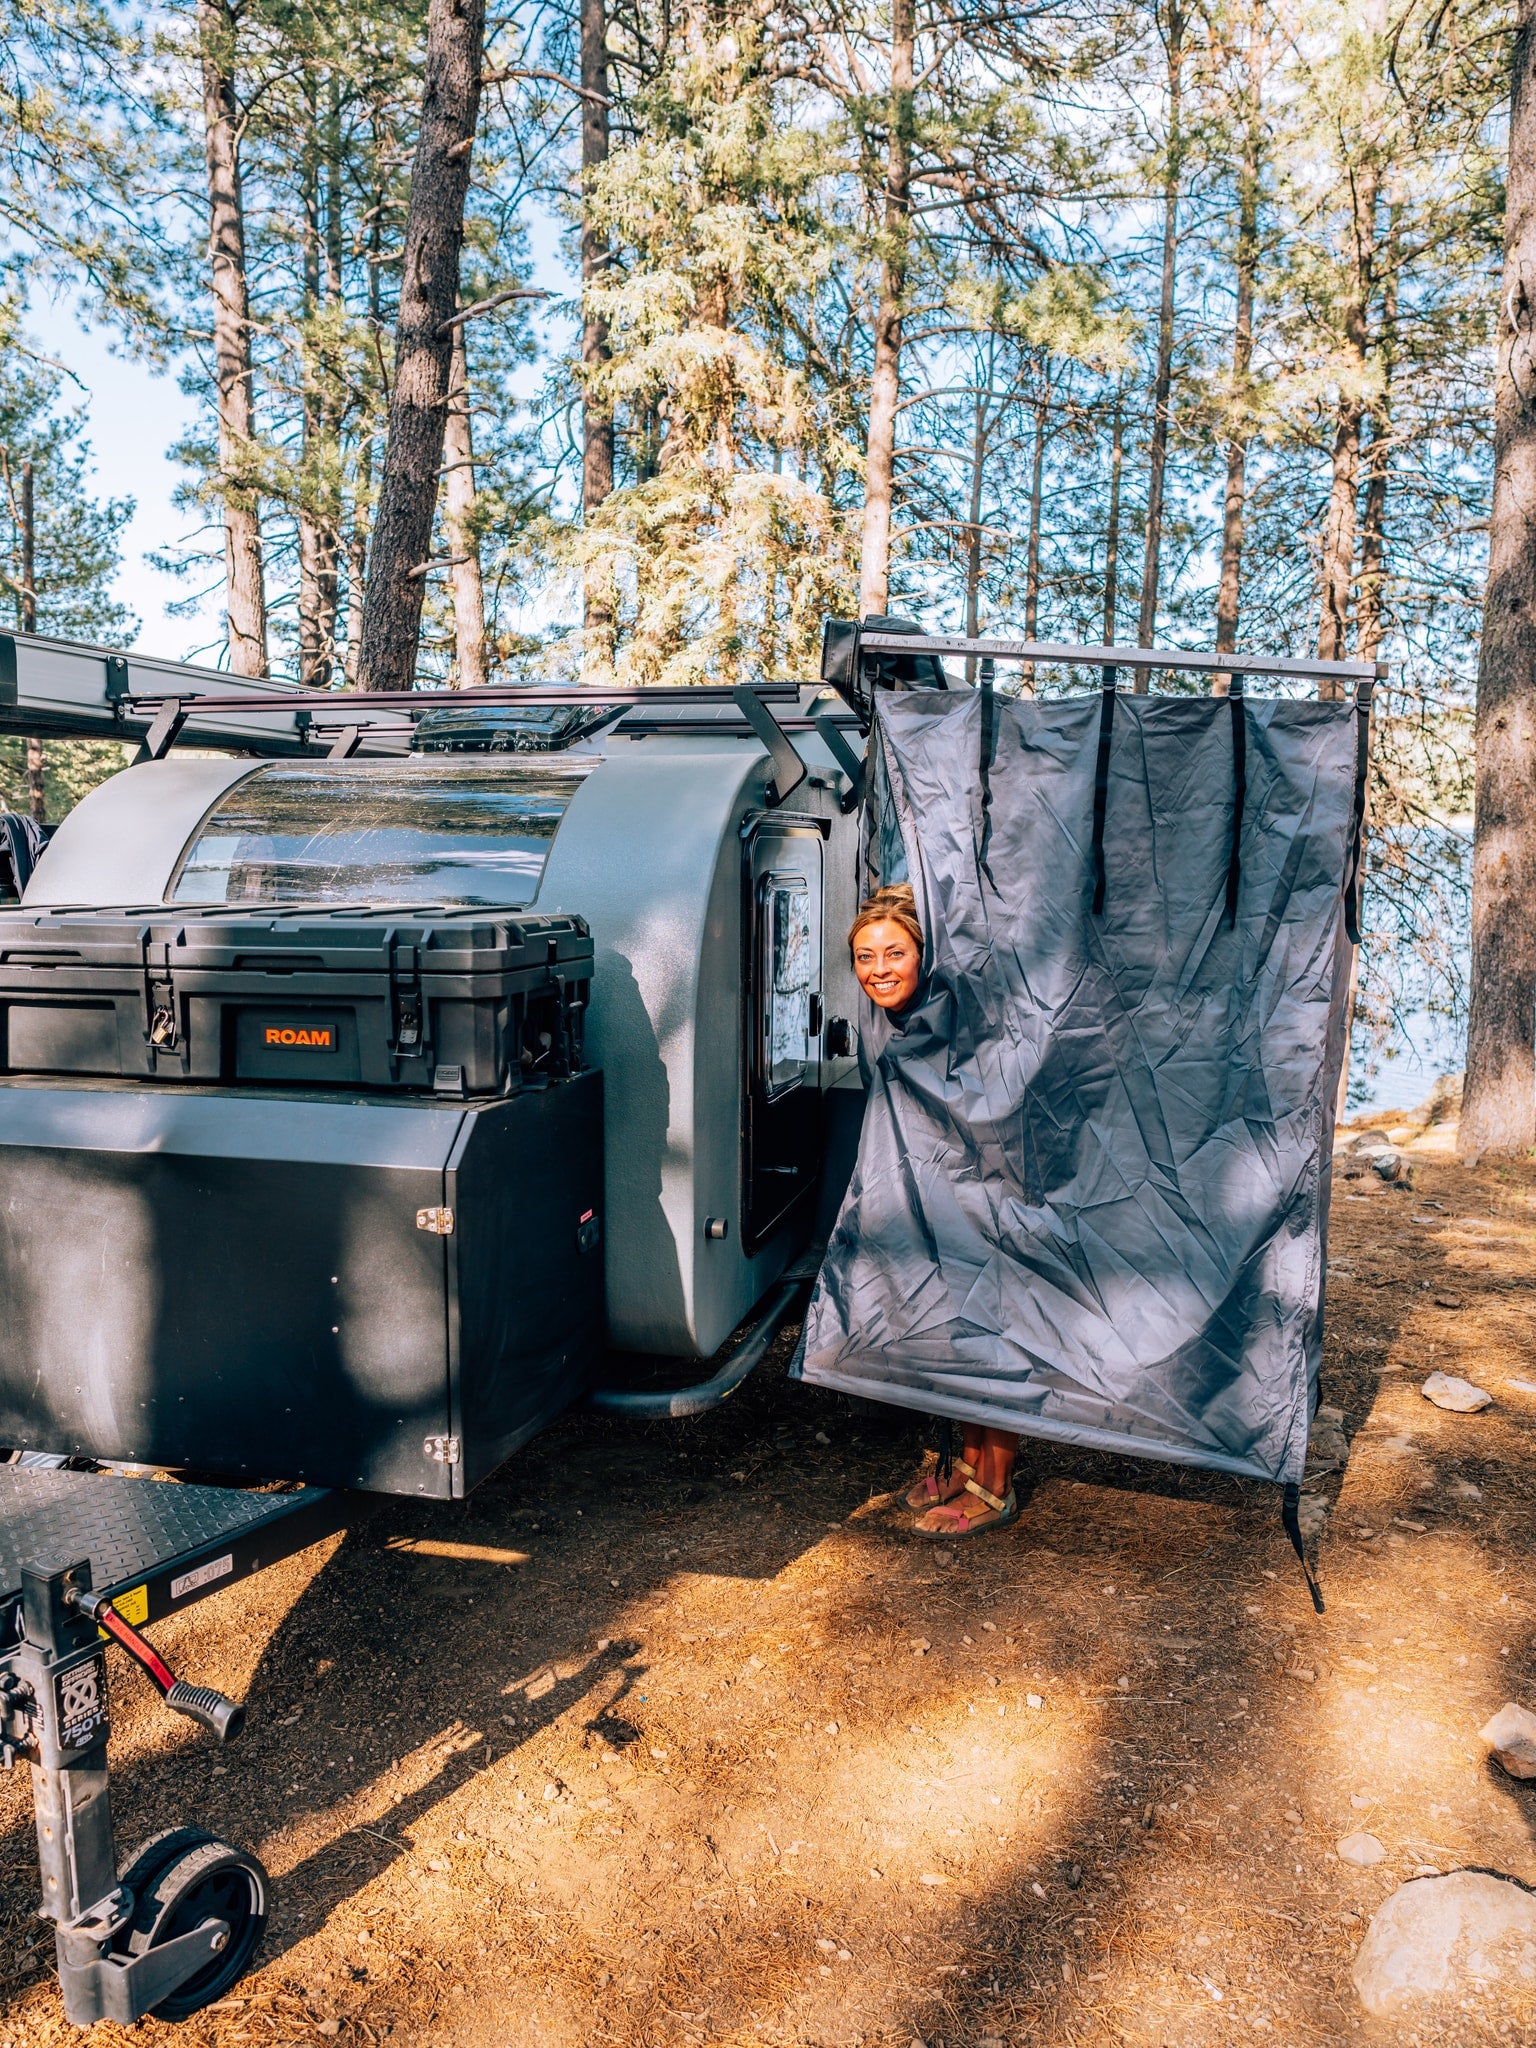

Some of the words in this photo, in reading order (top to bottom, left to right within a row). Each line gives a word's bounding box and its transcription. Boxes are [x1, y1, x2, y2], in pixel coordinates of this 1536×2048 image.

[265, 1028, 331, 1046] ROAM
[61, 1659, 95, 1682] EXTREME
[62, 1666, 96, 1688] OFFROAD
[61, 1709, 104, 1746] 750T
[64, 1706, 99, 1729] SERIES
